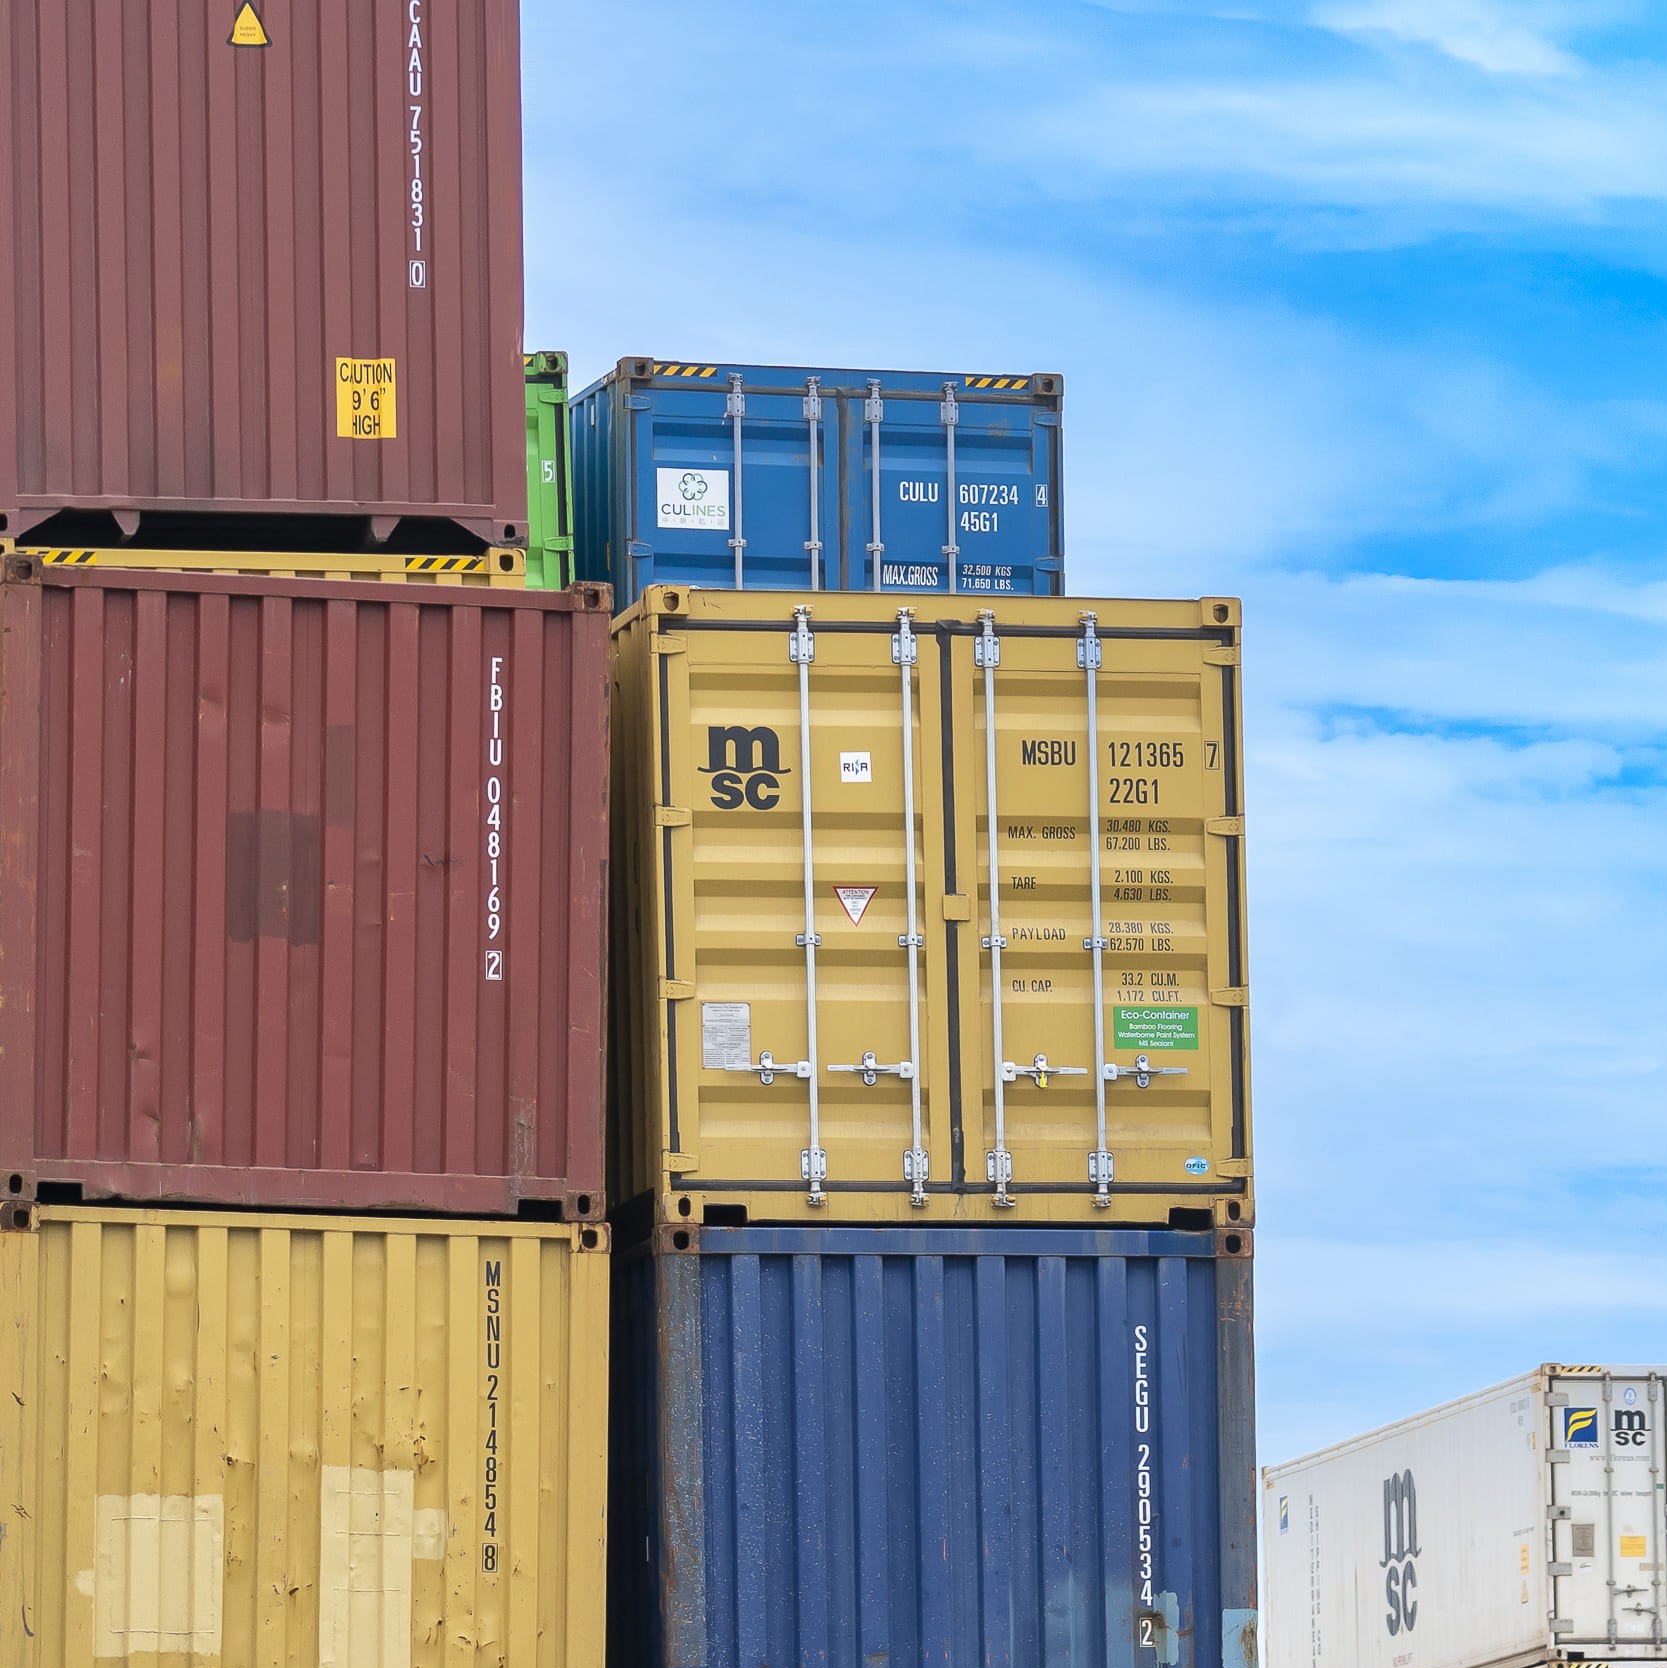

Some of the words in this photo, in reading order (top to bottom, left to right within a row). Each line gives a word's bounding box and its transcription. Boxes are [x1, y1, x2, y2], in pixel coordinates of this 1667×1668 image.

[408, 0, 422, 97] CAAU
[409, 106, 424, 252] 751831
[411, 262, 425, 286] 0
[340, 362, 393, 384] CAUTION
[899, 481, 939, 503] CULU
[959, 484, 1019, 506] 607234
[1036, 485, 1046, 506] 4
[661, 503, 726, 518] CULINES
[959, 511, 998, 533] 45G1
[995, 565, 1013, 578] KGS
[487, 657, 503, 765] FBIU
[1022, 740, 1077, 767] MSBU
[1108, 741, 1185, 769] 121365
[1206, 742, 1219, 769] 7
[1109, 778, 1161, 805] 22G1
[1007, 825, 1037, 840] MAX.
[1042, 826, 1076, 840] GROSS
[1148, 820, 1171, 834] KGS.
[1147, 838, 1170, 851] LBS.
[486, 776, 501, 940] 048169
[1011, 876, 1036, 890] TARE
[1150, 870, 1173, 884] KGS.
[1012, 927, 1066, 941] PAYLOAD
[1150, 922, 1174, 935] KGS.
[1151, 938, 1174, 951] LBS.
[487, 952, 501, 978] 2
[1120, 1010, 1190, 1020] Eco-Container
[1118, 1031, 1155, 1039] Waterborne
[1156, 1031, 1172, 1039] Paint
[1173, 1032, 1195, 1041] System
[1157, 1023, 1183, 1032] Flooring
[1150, 1040, 1174, 1048] Sealant
[485, 1260, 501, 1369] MSNU
[1134, 1325, 1150, 1433] SEGU
[484, 1374, 499, 1538] 214854
[1564, 1442, 1600, 1450] FLORENS
[1137, 1443, 1153, 1606] 290534
[483, 1544, 497, 1572] 8
[1140, 1618, 1154, 1647] 2
